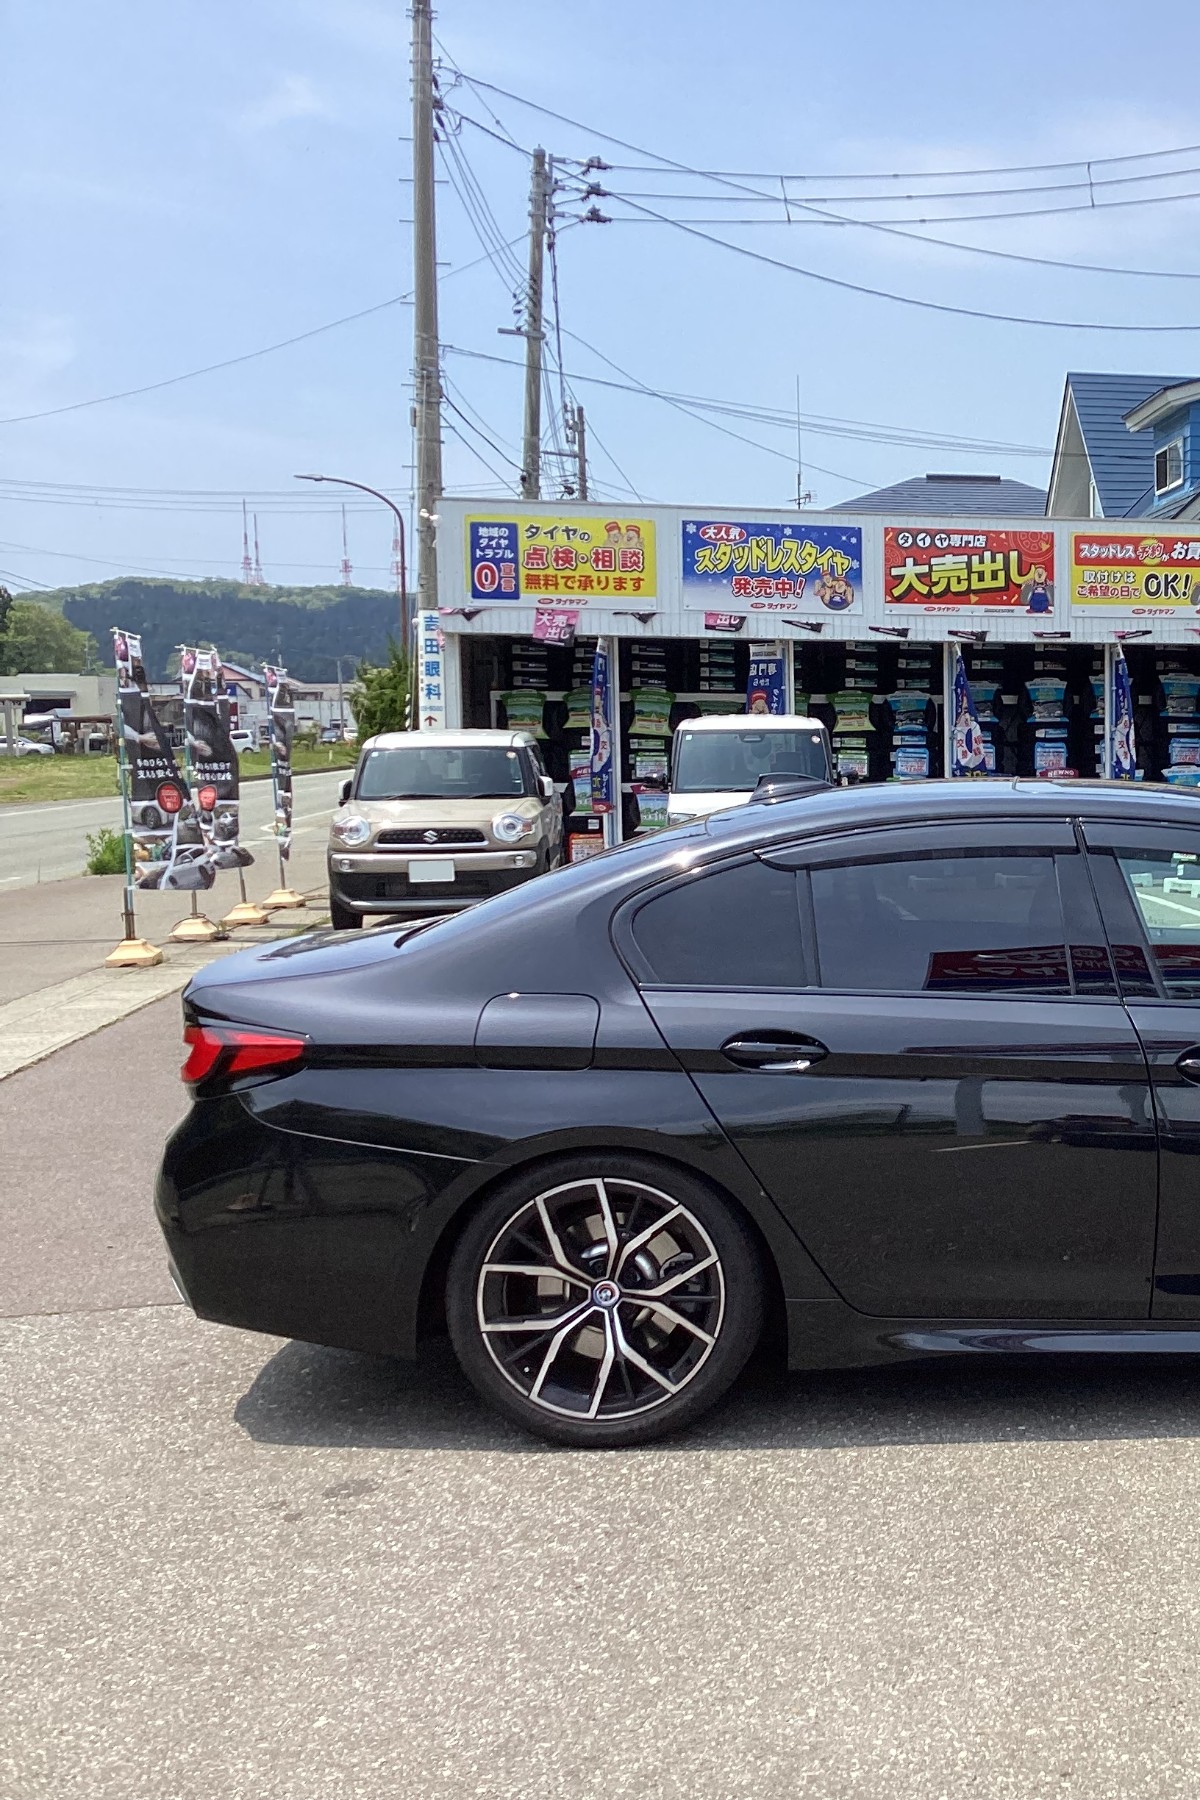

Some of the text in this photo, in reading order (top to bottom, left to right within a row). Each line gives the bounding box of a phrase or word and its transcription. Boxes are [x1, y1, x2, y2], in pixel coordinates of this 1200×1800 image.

[478, 526, 509, 538] 地域の
[524, 523, 591, 542] タイヤの
[704, 526, 741, 540] 大人気
[898, 531, 987, 549] タイヤ専門店
[479, 538, 509, 548] タイヤ
[475, 548, 514, 559] トラブル
[522, 544, 645, 573] 点検・相談
[695, 536, 852, 577] スタッドレスタイヤ
[474, 561, 499, 593] 0
[524, 573, 645, 592] 無料で承ります
[890, 550, 1036, 598] 大売出し
[1083, 570, 1136, 584] 取付けは
[732, 576, 806, 599] 発売中!
[1077, 585, 1142, 599] ご希望の日で
[1143, 572, 1192, 600] OK!
[536, 613, 568, 626] 大売
[717, 613, 738, 625] 出し
[545, 627, 570, 639] 出し
[423, 614, 441, 701] 吉田眼科
